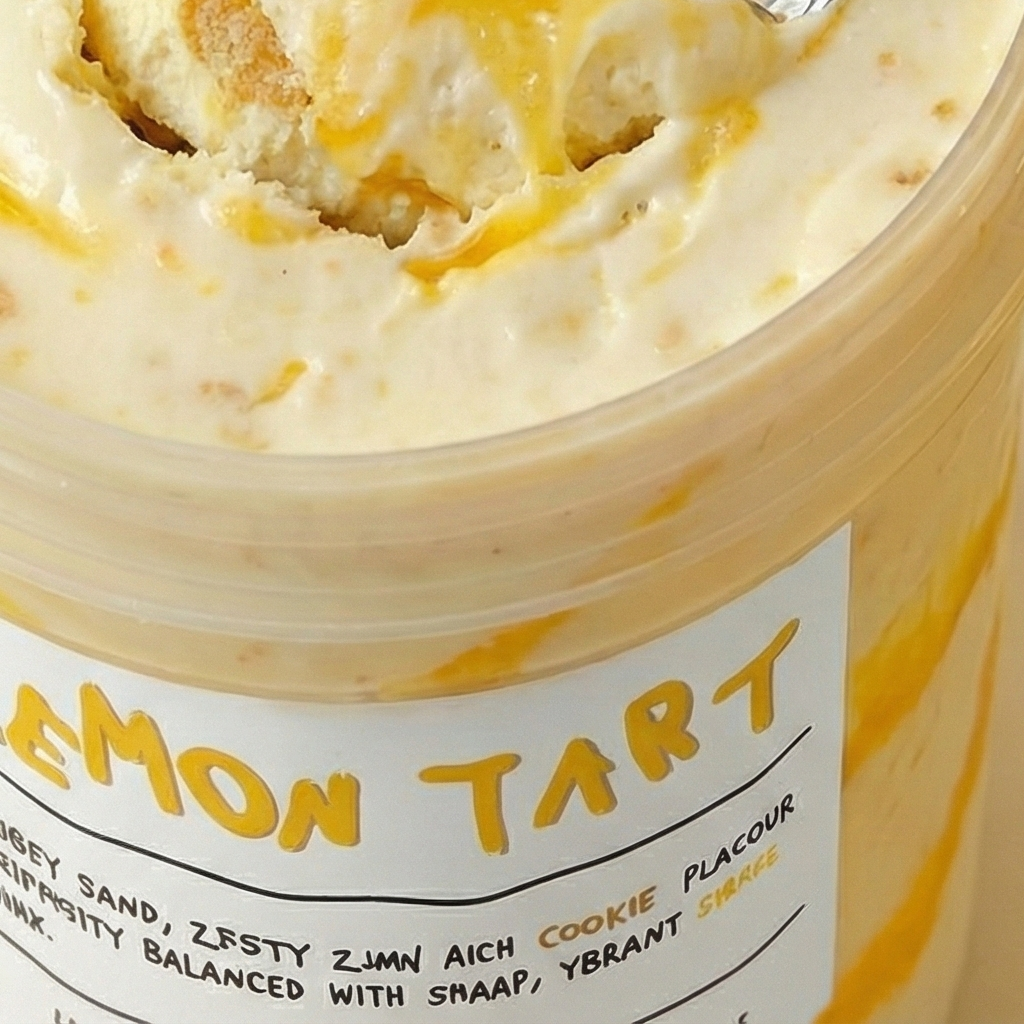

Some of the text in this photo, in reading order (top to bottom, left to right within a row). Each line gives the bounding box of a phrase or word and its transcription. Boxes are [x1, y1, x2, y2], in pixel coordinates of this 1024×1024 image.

[0, 617, 801, 856] EMON TART
[77, 872, 172, 936] SAND,
[443, 935, 515, 971] AICH
[537, 885, 658, 949] COOKIE
[143, 936, 305, 1001] BALANCED
[329, 981, 405, 1008] WITH
[559, 910, 683, 981] YBRANT
